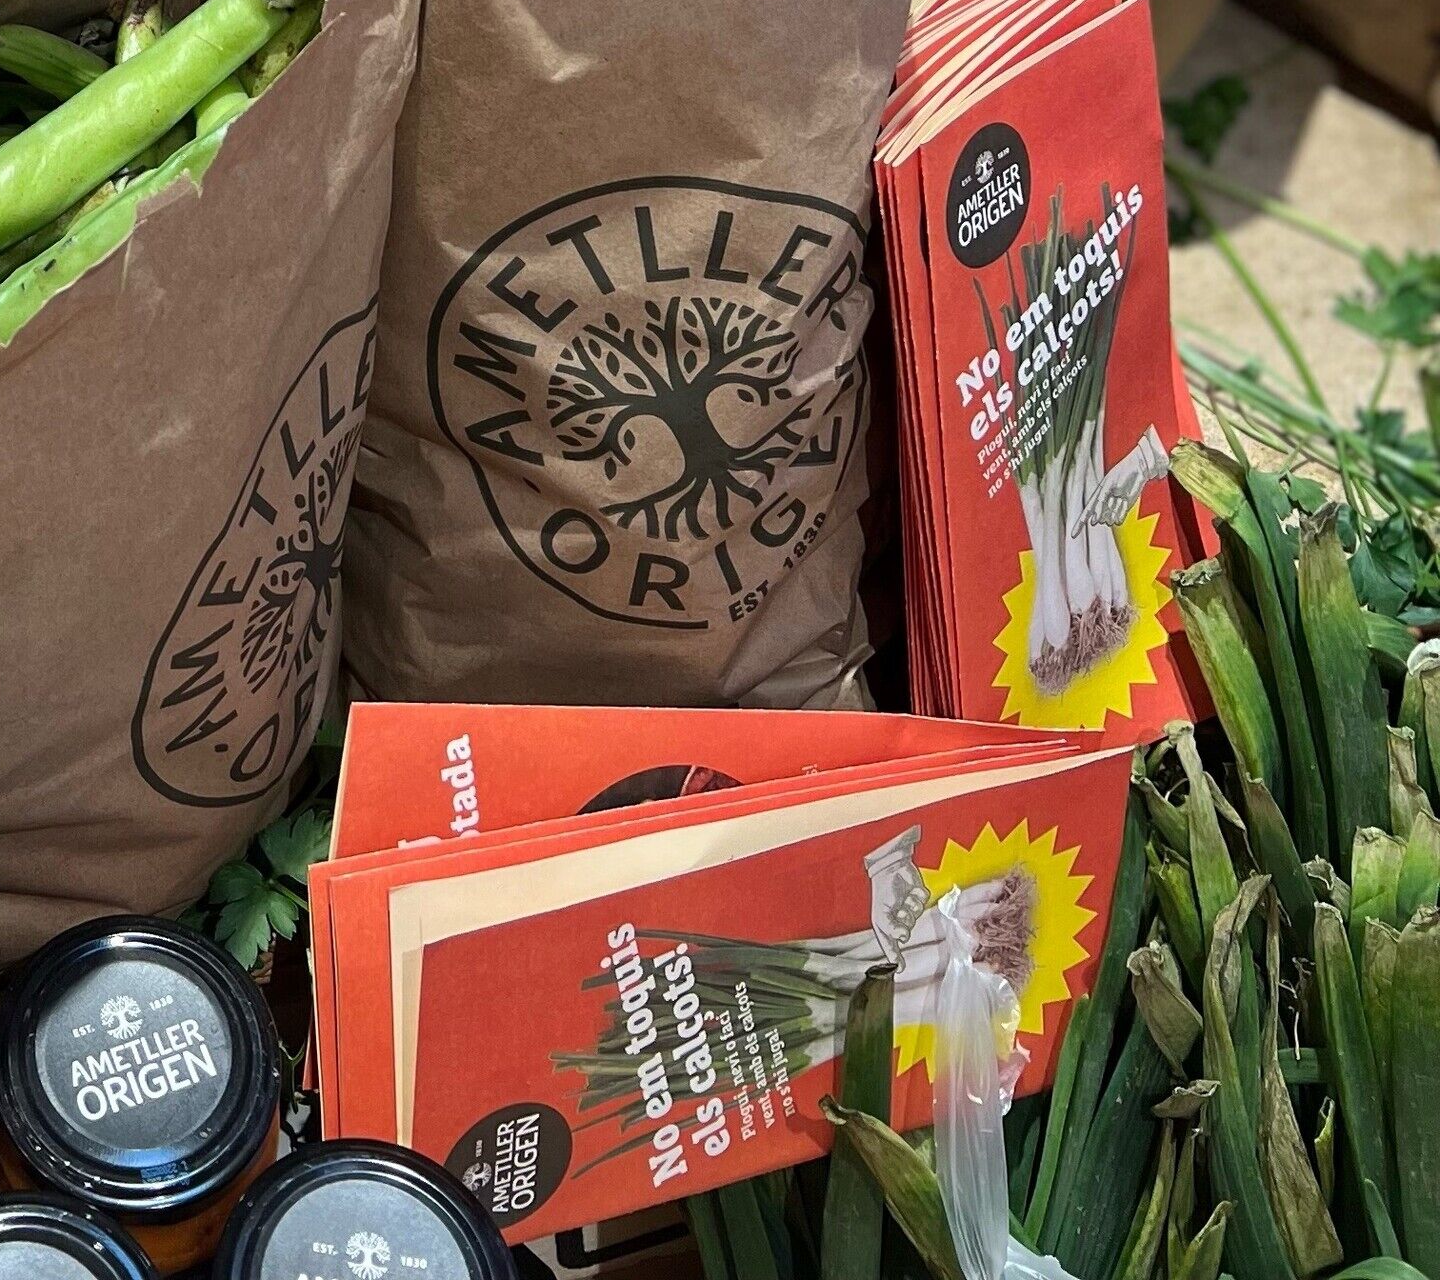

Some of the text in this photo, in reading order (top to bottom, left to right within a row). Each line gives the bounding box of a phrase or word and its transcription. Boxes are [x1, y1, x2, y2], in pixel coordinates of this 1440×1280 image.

[958, 163, 1020, 224] AMETLLER
[958, 181, 1024, 246] ORIGEN
[956, 184, 1143, 407] No em toquis
[969, 249, 1124, 441] els calçots!
[976, 353, 1072, 465] Plogui, nevi o faci
[982, 354, 1089, 481] vent, amb els calçots
[987, 418, 1053, 499] no s'hi juga!
[160, 328, 377, 754] AMETLLE
[441, 733, 481, 838] tada
[71, 1019, 205, 1088] AMETLLER
[72, 994, 174, 1038] EST. 1830
[600, 922, 688, 1188] No em toquis
[653, 942, 731, 1157] els calçots!
[735, 981, 776, 1129] vent, amb els calçots
[76, 1043, 218, 1121] ORIGEN
[716, 1009, 757, 1141] Plogui, nevi o faci
[764, 1027, 796, 1117] no s'hi juga!
[492, 1119, 515, 1213] AMETLLER
[511, 1113, 540, 1210] ORIGEN
[312, 1241, 428, 1270] EST. 1830
